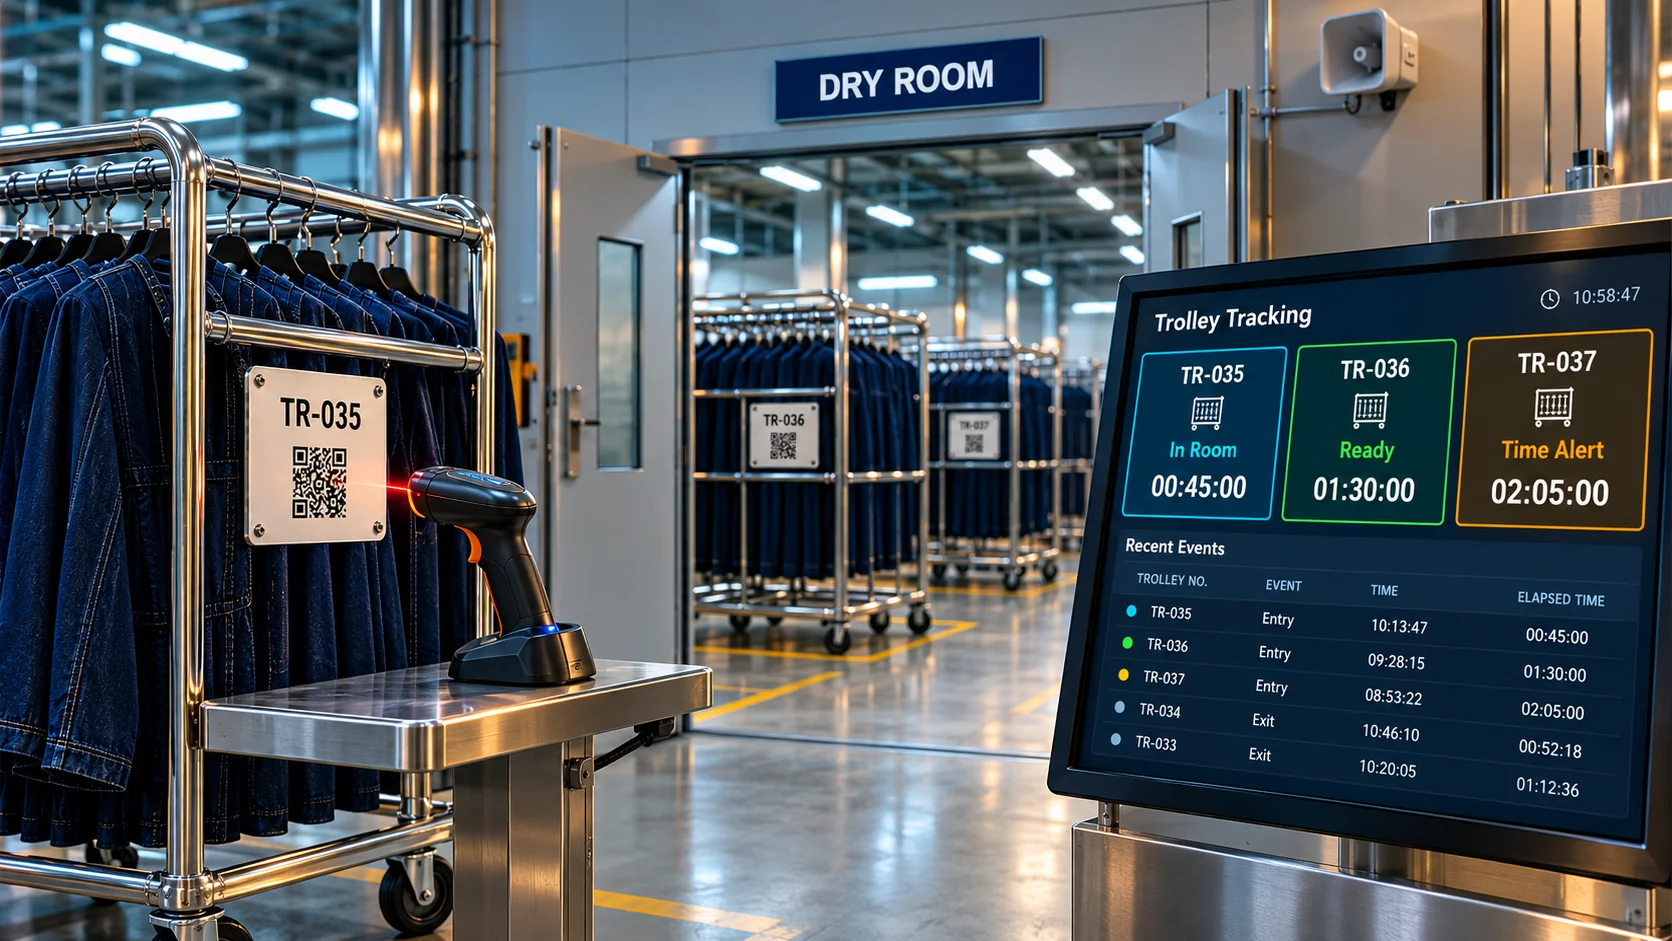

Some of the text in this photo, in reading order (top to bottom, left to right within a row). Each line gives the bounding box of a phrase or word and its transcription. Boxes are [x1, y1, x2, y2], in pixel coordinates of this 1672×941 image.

[820, 60, 993, 101] DRY ROOM
[1573, 287, 1641, 305] 10:58:47
[1155, 305, 1311, 334] Trolley Tracking
[1340, 358, 1410, 380] TR-036
[1518, 350, 1596, 373] TR-037
[1181, 365, 1245, 385] TR-035
[280, 397, 361, 430] TR-035
[763, 413, 805, 427] TR-036
[1169, 442, 1237, 458] In Room
[1340, 440, 1394, 463] Ready
[1501, 439, 1605, 460] Time Alert
[1152, 475, 1246, 498] 00:45:00
[1314, 477, 1414, 502] 01:30:00
[1492, 479, 1608, 506] 02:05:00
[1125, 538, 1225, 556] Recent Events
[1137, 573, 1208, 587] TROLLEY NO.
[1265, 580, 1303, 592] EVENT
[1370, 585, 1399, 597] TIME
[1517, 592, 1605, 607] ELAPSED TIME
[1151, 606, 1192, 620] TR-035
[1262, 612, 1295, 630] Entry
[1372, 619, 1428, 635] 10:13:47
[1147, 638, 1189, 653] TR-036
[1526, 628, 1589, 645] 00:45:00
[1259, 646, 1292, 663] Entry
[1368, 653, 1425, 670] 09:28:15
[1143, 670, 1186, 686] TR-037
[1523, 665, 1587, 683] 01:30:00
[1255, 679, 1289, 697] Entry
[1365, 688, 1423, 706] 08:53:22
[1139, 703, 1181, 719] TR-034
[1521, 702, 1585, 721] 02:05:00
[1252, 713, 1276, 728] Exit
[1363, 724, 1420, 742] 10:46:10
[1135, 735, 1177, 752] TR-033
[1518, 739, 1582, 759] 00:52:18
[1249, 748, 1272, 763] Exit
[1360, 760, 1417, 779] 10:20:05
[1516, 777, 1580, 798] 01:12:36
